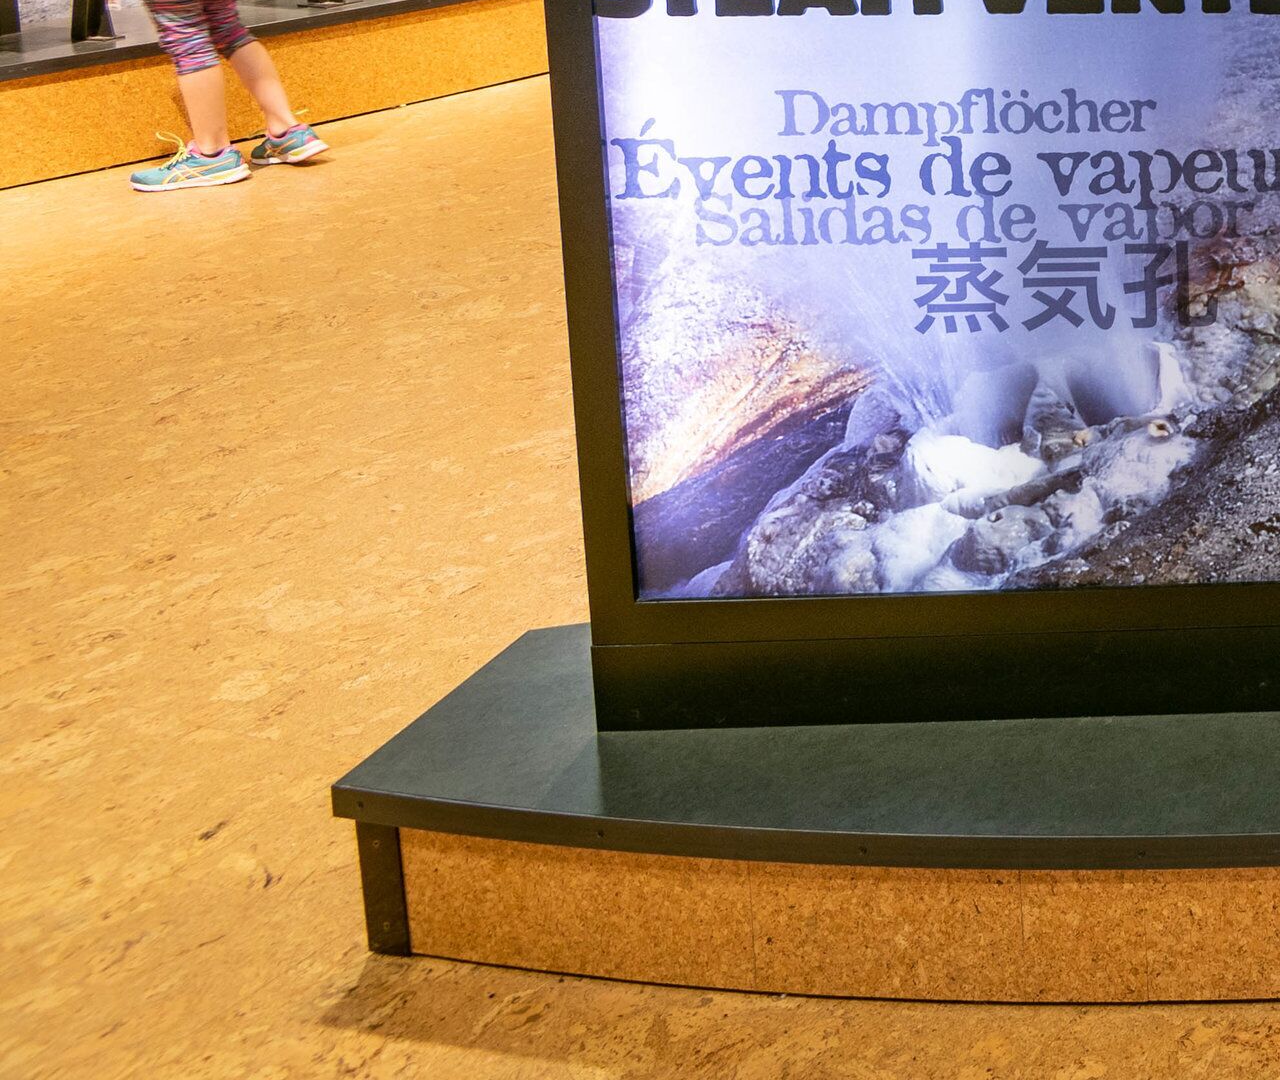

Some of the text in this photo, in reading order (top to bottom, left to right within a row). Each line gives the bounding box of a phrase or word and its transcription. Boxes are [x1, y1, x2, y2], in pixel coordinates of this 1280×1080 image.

[775, 88, 1157, 147] Dampflöcher
[611, 118, 891, 199] Évents
[919, 136, 1012, 197] de
[695, 190, 1255, 246] Salidas de vapor
[912, 240, 1219, 334] 蒸気孔
